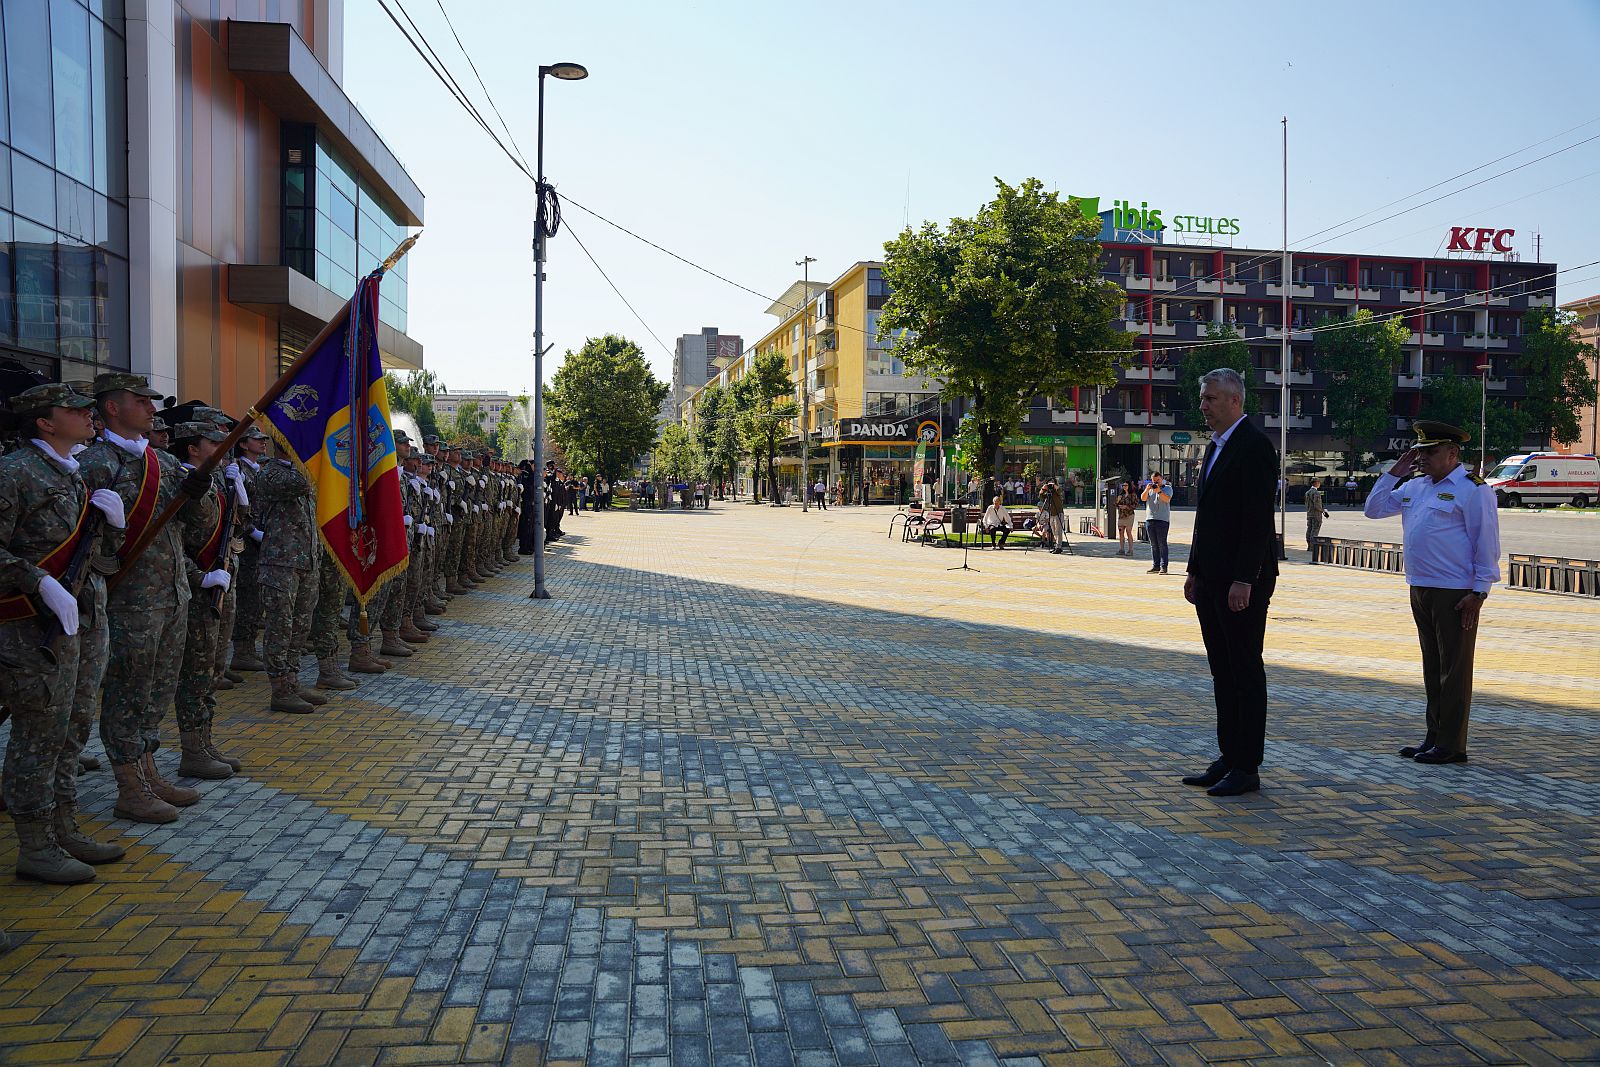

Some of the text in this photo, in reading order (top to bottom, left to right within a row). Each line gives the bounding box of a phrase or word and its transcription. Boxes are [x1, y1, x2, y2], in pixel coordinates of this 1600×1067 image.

[1113, 200, 1163, 231] ibis
[1446, 227, 1515, 251] KFC
[850, 423, 907, 437] PANDA
